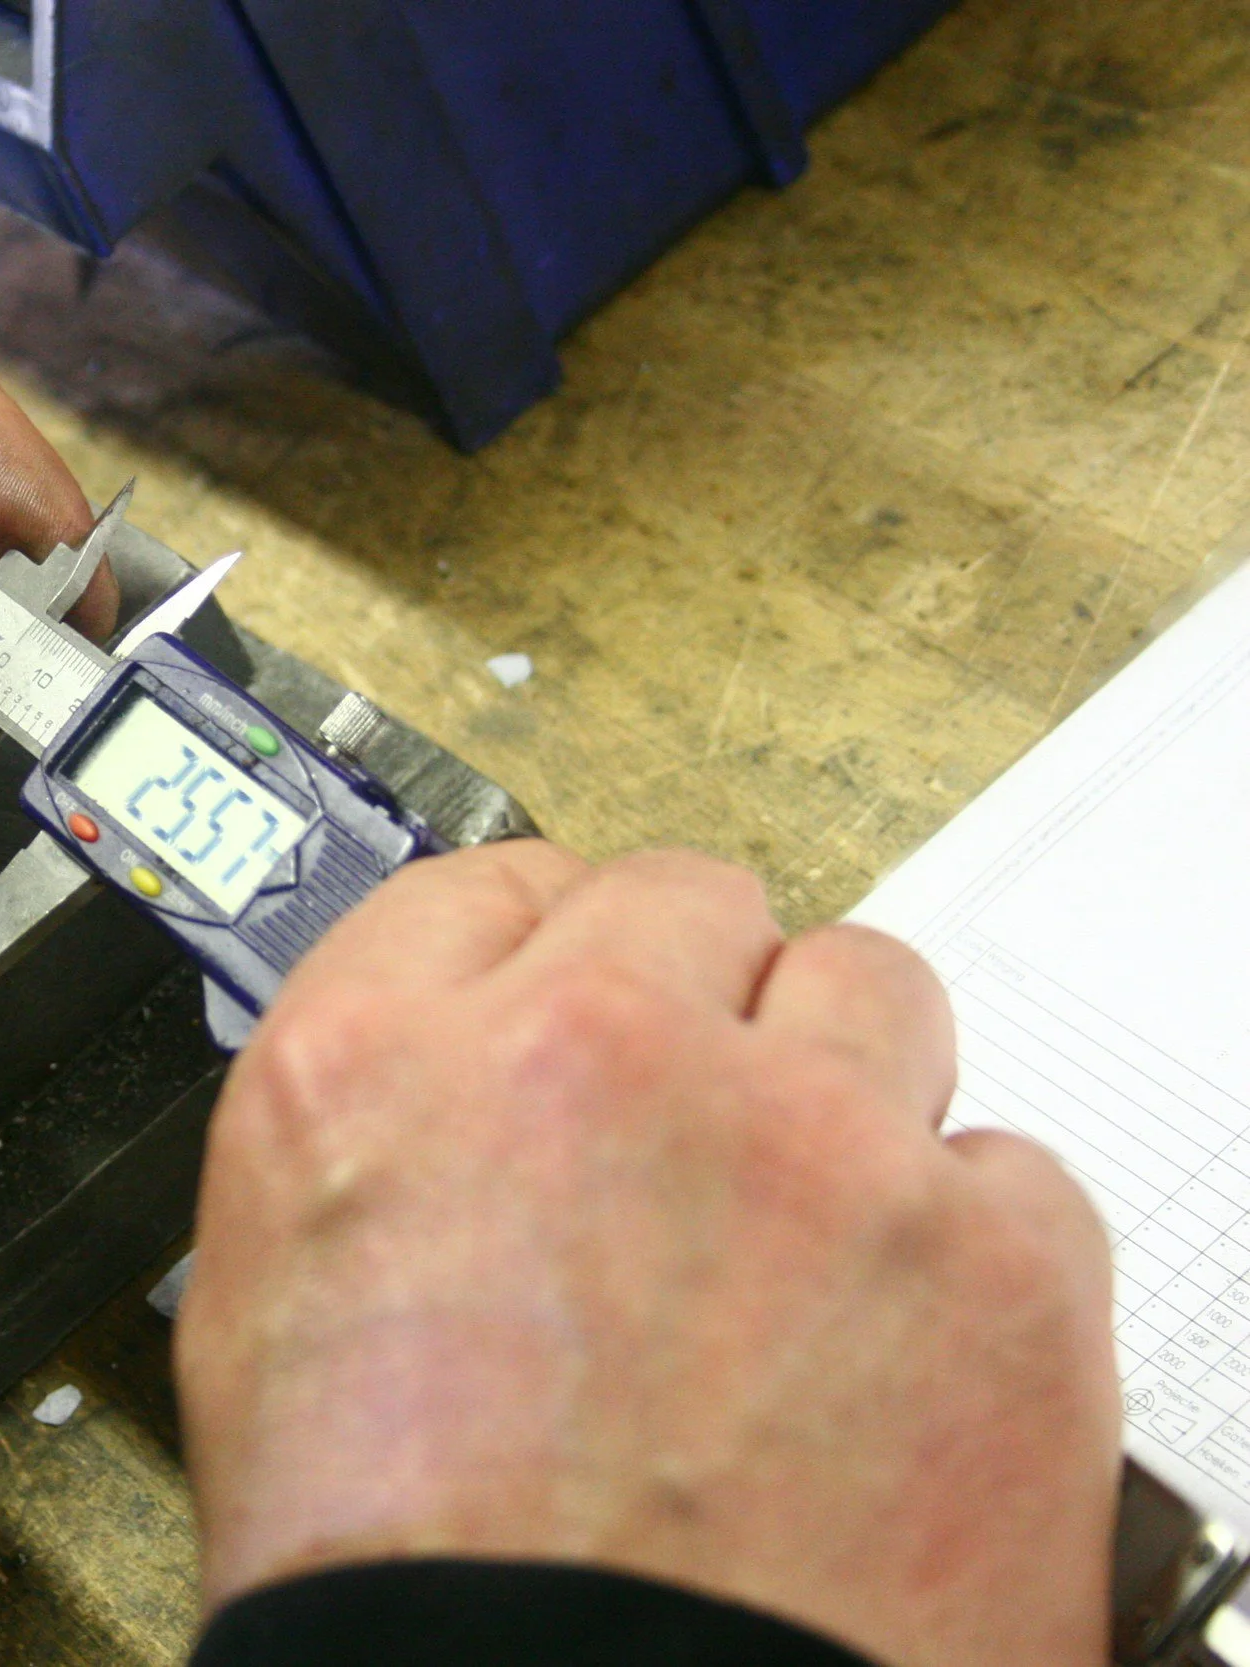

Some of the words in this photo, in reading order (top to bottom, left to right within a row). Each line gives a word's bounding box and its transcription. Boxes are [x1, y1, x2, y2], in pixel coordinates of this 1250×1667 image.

[32, 668, 53, 690] 10
[1206, 1308, 1232, 1328] 1000
[1182, 1329, 1210, 1349] 1500
[1157, 1349, 1186, 1370] 2000
